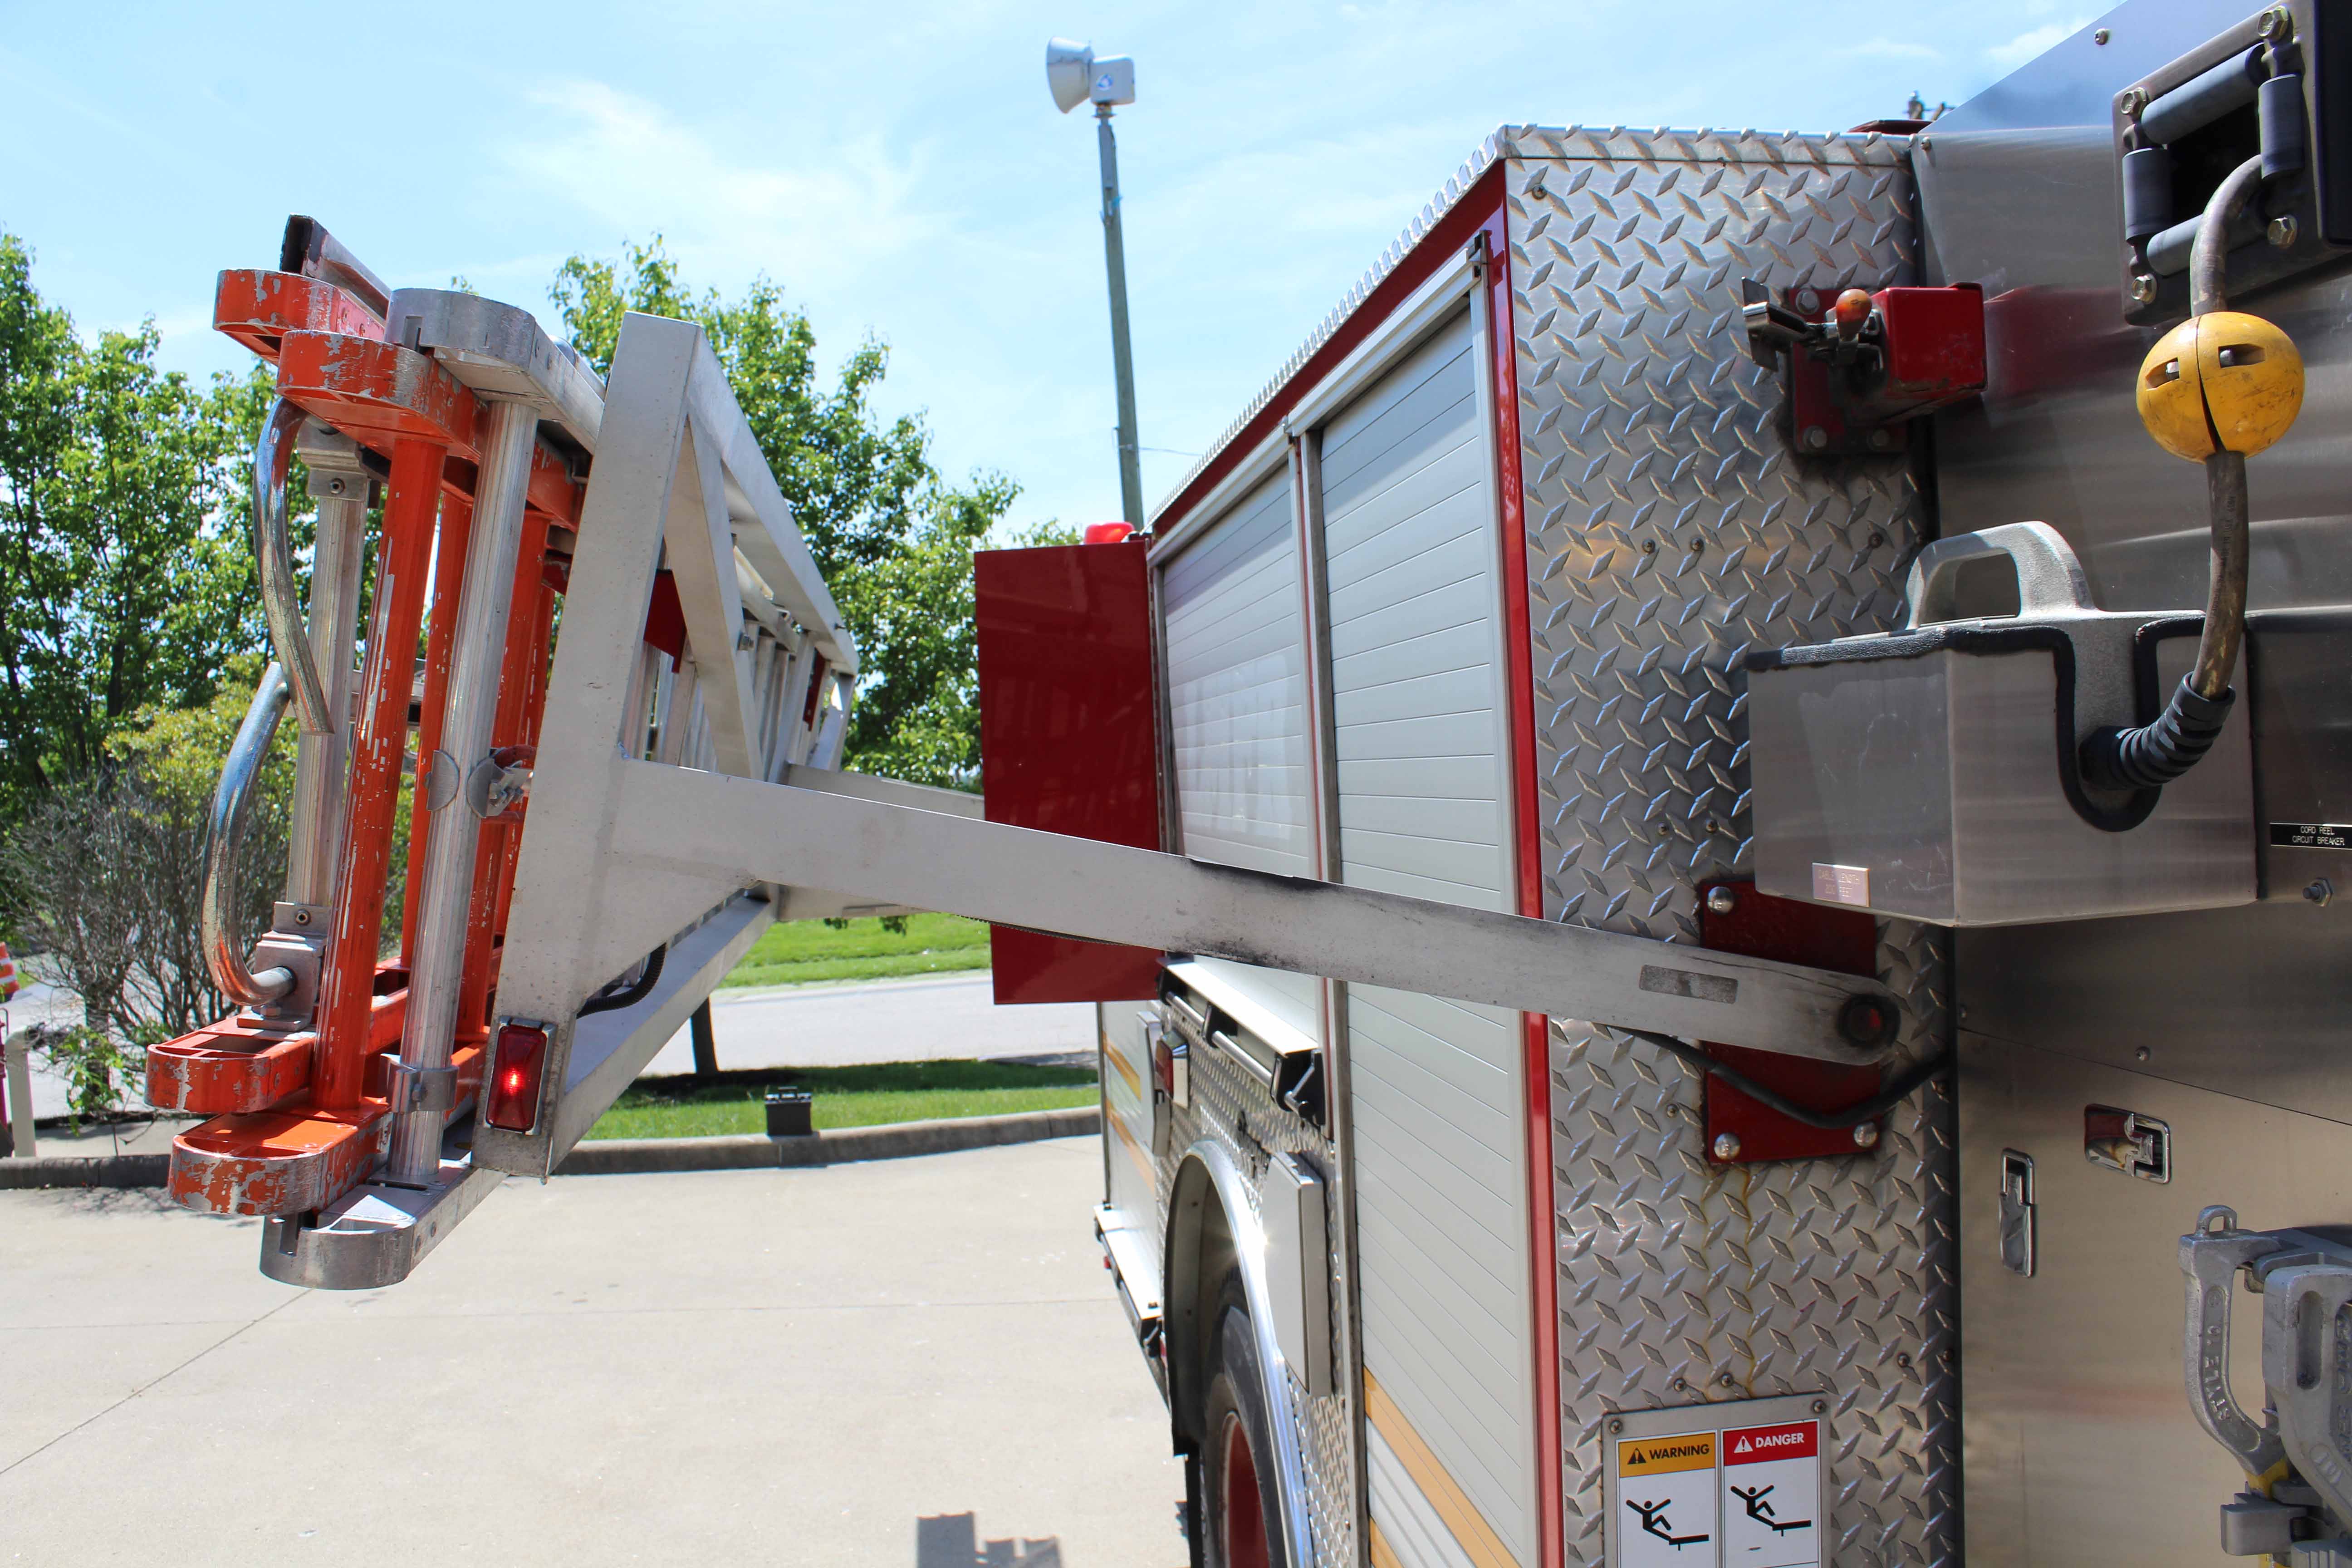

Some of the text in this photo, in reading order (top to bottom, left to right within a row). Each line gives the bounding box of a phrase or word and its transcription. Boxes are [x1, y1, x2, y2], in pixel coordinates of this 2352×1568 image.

[2300, 826, 2335, 835] CORD REEL
[2292, 835, 2345, 846] CIRCUIT BREAKER
[1755, 1432, 1804, 1448] DANGER
[1649, 1443, 1710, 1460] WARNING
